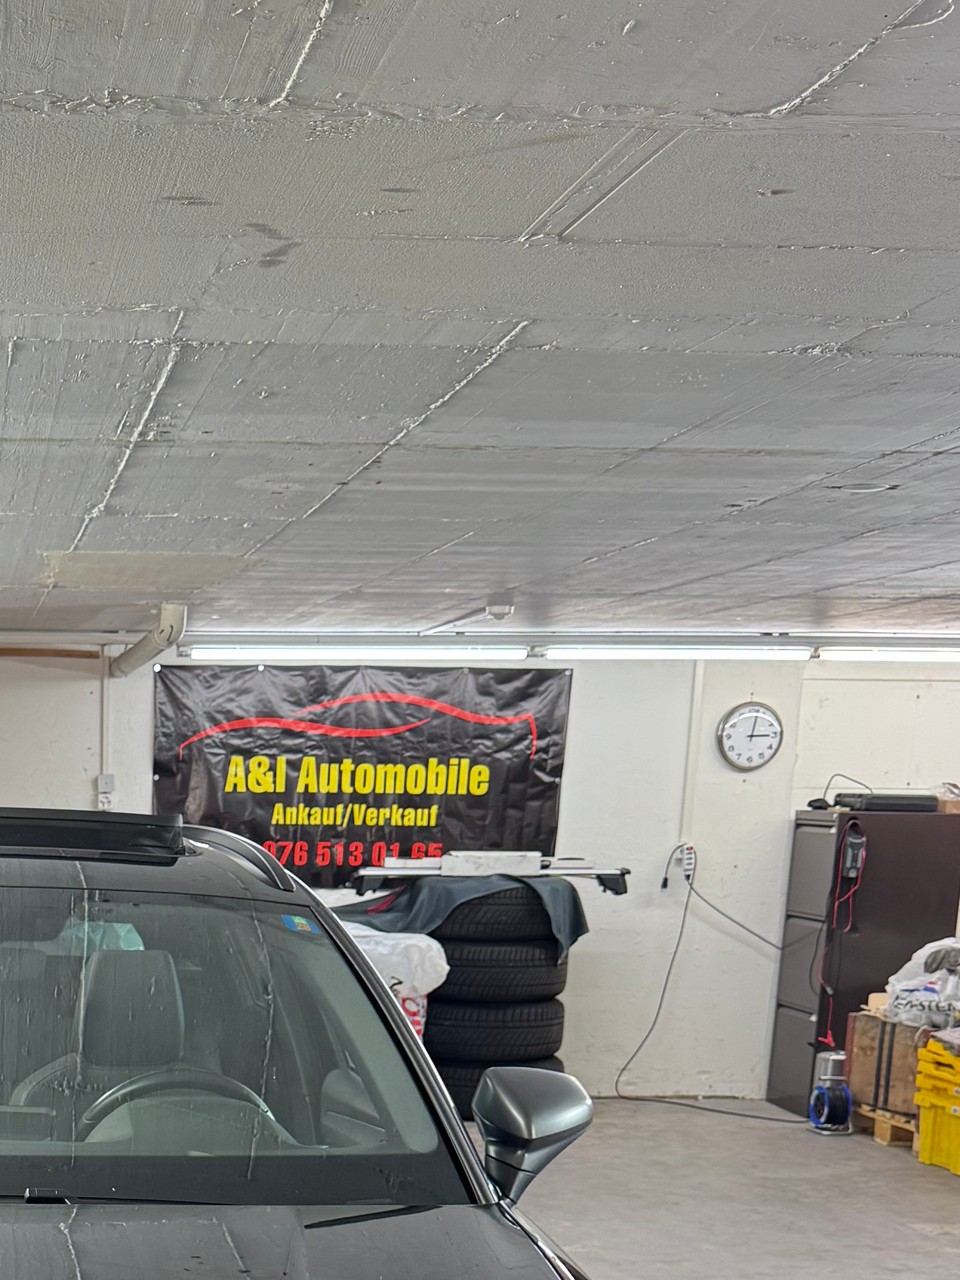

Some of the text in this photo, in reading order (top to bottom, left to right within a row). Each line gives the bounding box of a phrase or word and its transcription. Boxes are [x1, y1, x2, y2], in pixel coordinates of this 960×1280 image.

[224, 755, 490, 796] A&I Automobile
[271, 803, 439, 828] Ankauf/Verkauf
[316, 841, 364, 867] 513
